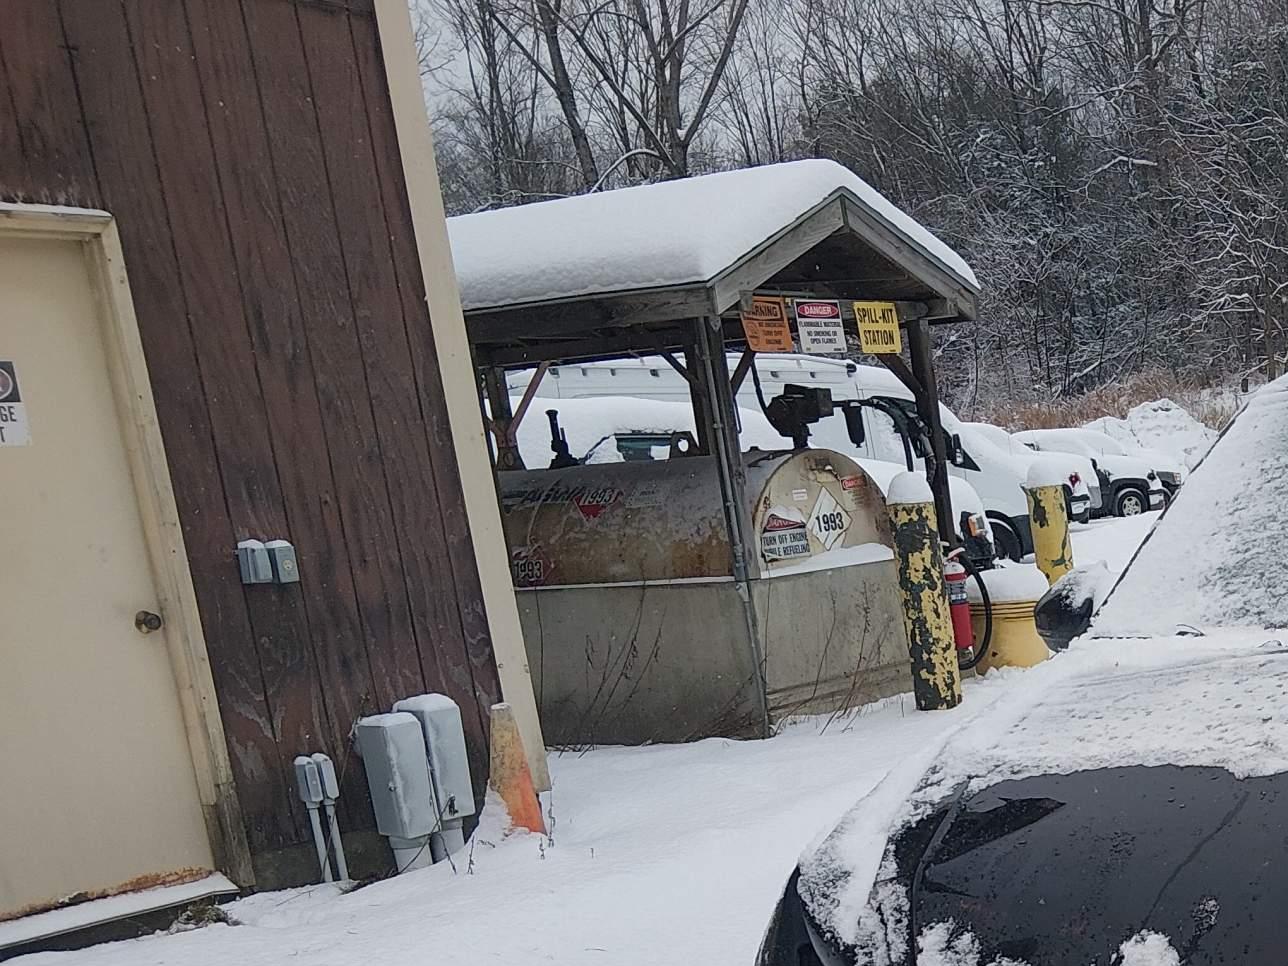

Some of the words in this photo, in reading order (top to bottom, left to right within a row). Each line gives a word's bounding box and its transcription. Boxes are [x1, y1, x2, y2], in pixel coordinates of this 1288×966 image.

[804, 306, 832, 315] DANGER
[857, 307, 895, 323] SPILL-KIT
[863, 329, 895, 346] STATION
[583, 487, 614, 504] 1993
[815, 512, 844, 533] 1993
[763, 535, 777, 546] TURN
[778, 533, 788, 544] OFF
[783, 544, 810, 557] REFUELING
[513, 560, 542, 579] 1993
